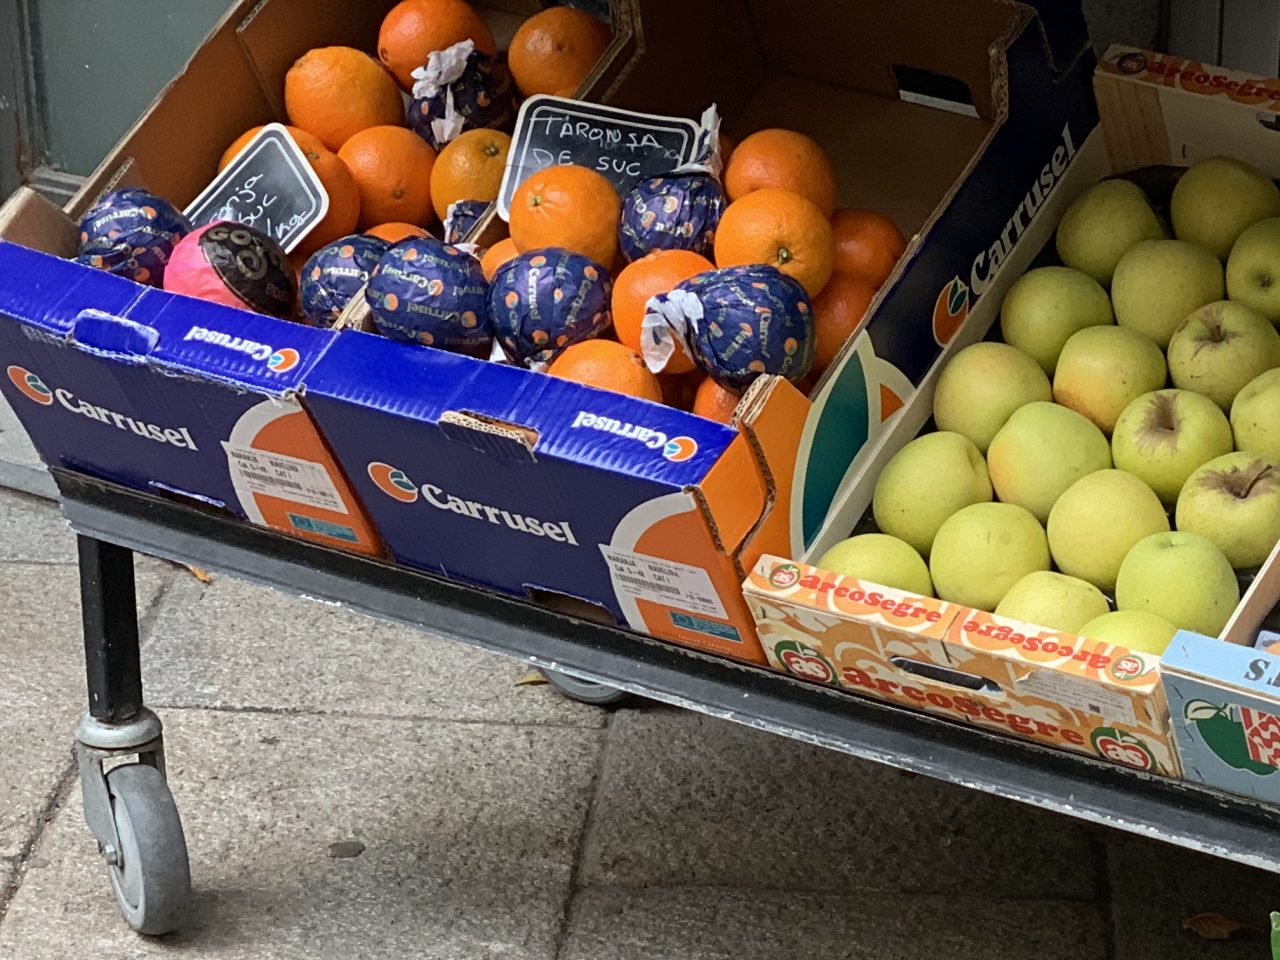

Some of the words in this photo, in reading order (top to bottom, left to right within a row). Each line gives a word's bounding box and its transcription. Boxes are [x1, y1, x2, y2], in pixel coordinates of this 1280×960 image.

[533, 148, 574, 166] DE
[596, 156, 641, 176] SUC
[971, 121, 1076, 296] Carrusel
[183, 325, 273, 361] Carrusel
[55, 388, 199, 451] Carrusel
[571, 411, 667, 449] Carrusel
[421, 483, 579, 546] Carrusel
[799, 574, 942, 623] arcoSegre
[963, 620, 1112, 670] arcoSegre
[842, 665, 1085, 745] arcoSegre
